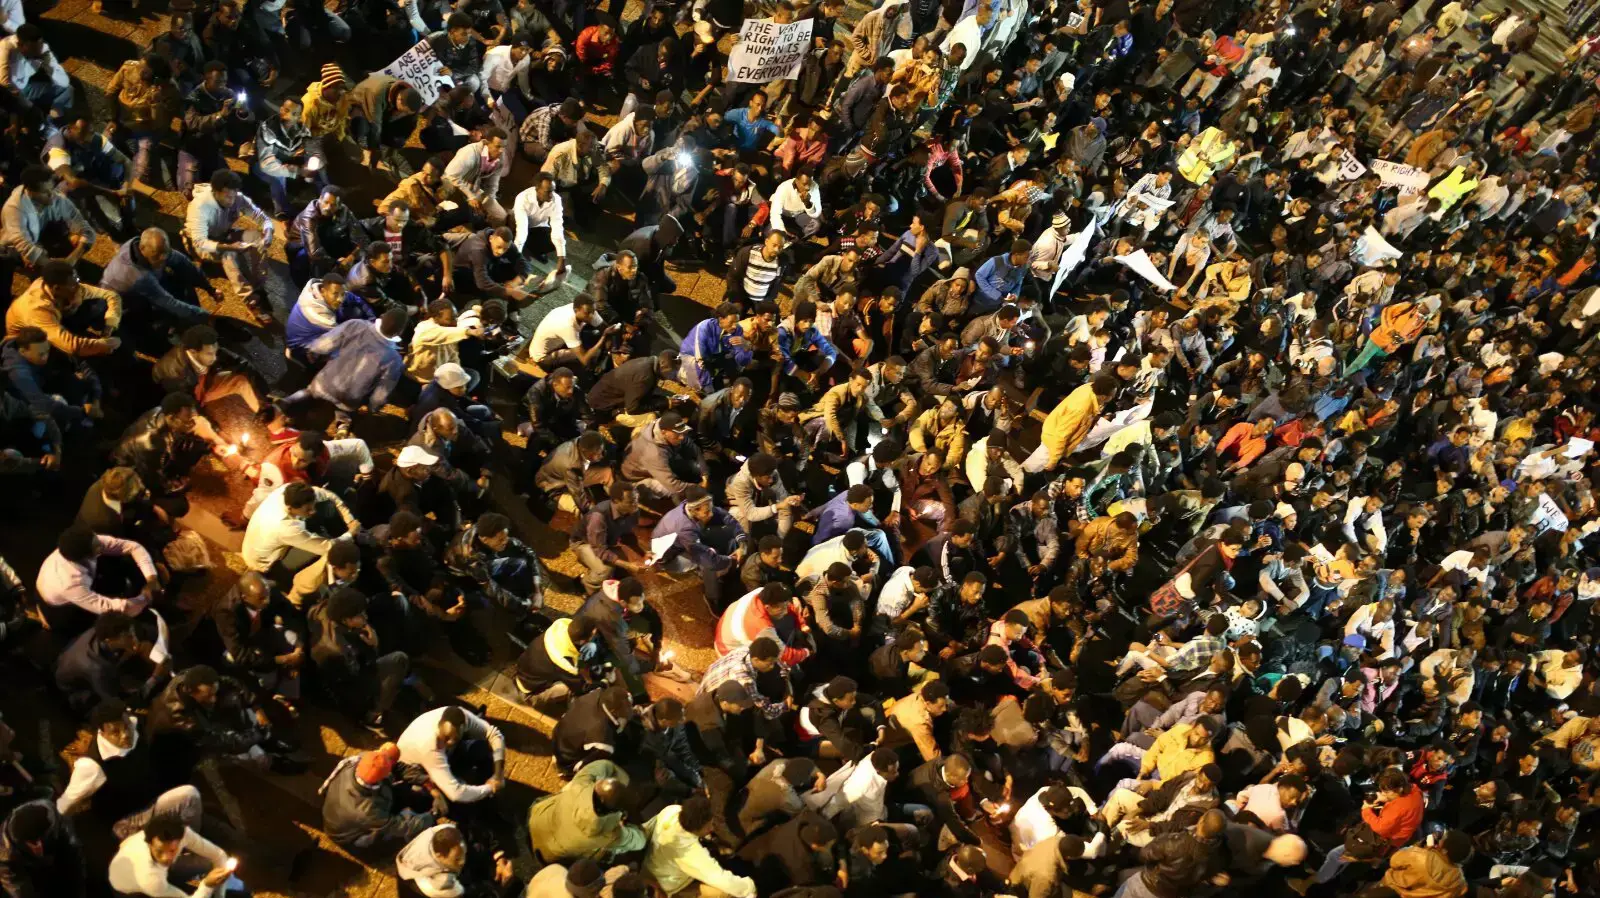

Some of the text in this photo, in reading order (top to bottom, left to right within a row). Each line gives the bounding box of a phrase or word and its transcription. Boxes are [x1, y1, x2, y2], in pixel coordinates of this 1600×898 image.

[748, 21, 800, 35] THE VERY
[744, 31, 811, 45] RIGHT TO BE
[398, 52, 416, 71] ARE
[415, 41, 432, 57] ALL
[745, 43, 799, 55] HUMAN IS
[757, 52, 800, 66] DENIED
[737, 63, 796, 80] EVERYDAY
